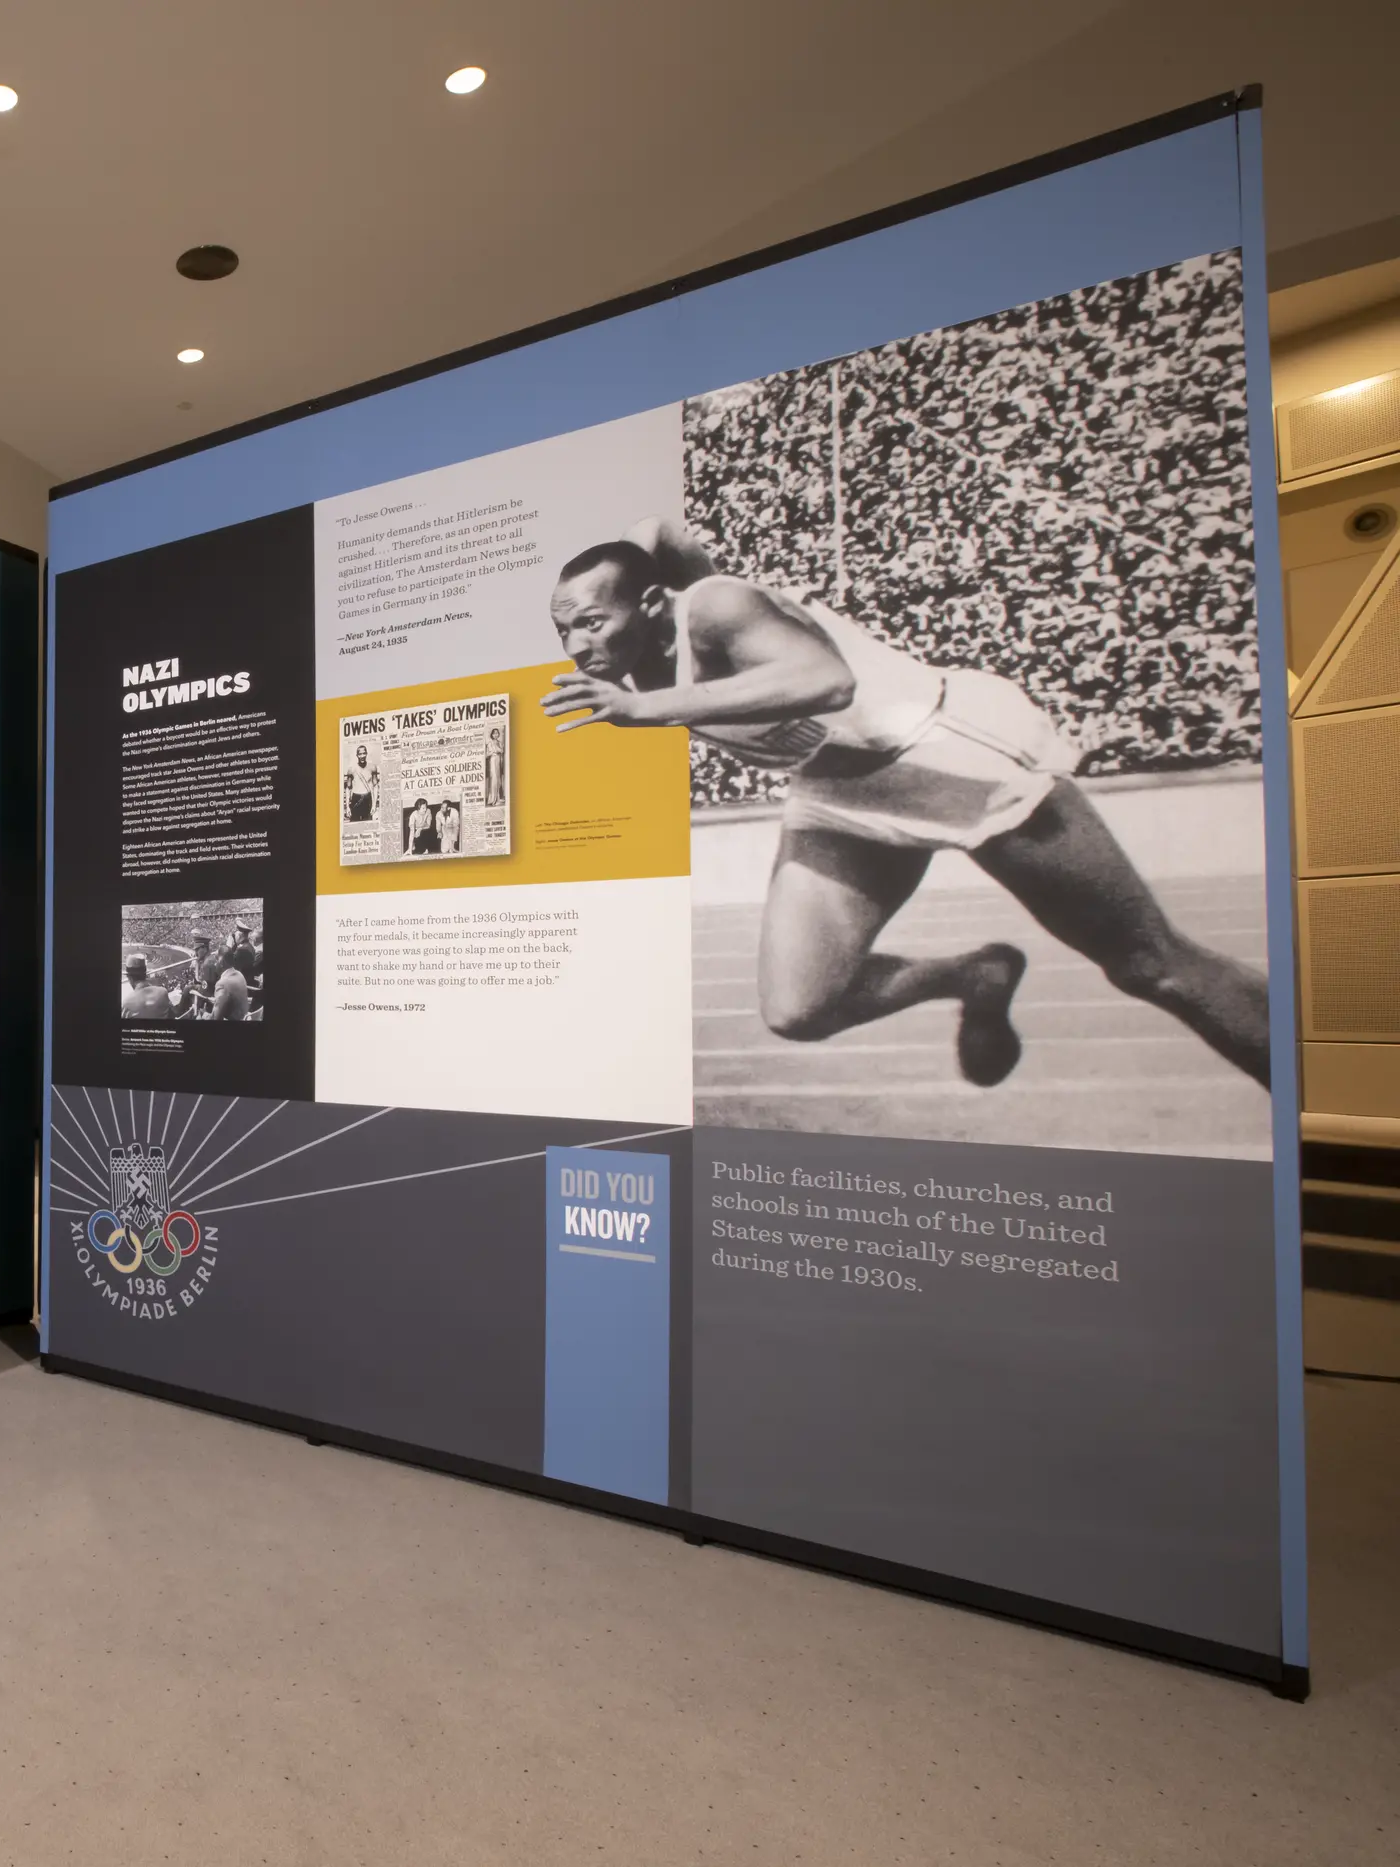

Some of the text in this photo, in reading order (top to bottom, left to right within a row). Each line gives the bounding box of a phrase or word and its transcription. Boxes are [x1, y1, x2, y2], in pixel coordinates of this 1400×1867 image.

[335, 502, 413, 527] “To Jesse Owens
[336, 611, 472, 641] —New York Amsterdam News,
[338, 635, 408, 655] August 24, 1935
[123, 657, 179, 687] NAZI
[122, 671, 250, 713] OLYMPICS
[344, 699, 506, 737] OWENS ‘TAKES’ OLYMPICS
[401, 761, 482, 779] SELASSIE'S SOLDIERS
[403, 773, 484, 791] AT GATES OF ADDIS
[335, 909, 579, 927] “After I came home from the 1936 Olympics with
[336, 1002, 425, 1012] —Jesse Owens, 1972
[560, 1167, 654, 1206] DID YOU
[711, 1161, 1114, 1213] Public facilities, churches, and
[564, 1205, 650, 1243] KNOW?
[711, 1191, 1107, 1246] schools in much of the United
[711, 1218, 1119, 1282] States were racially segregated
[76, 1248, 178, 1320] OLYMPIADE
[180, 1226, 219, 1307] BERLIN
[711, 1247, 922, 1292] during the 1930s.
[126, 1278, 167, 1296] 1936
